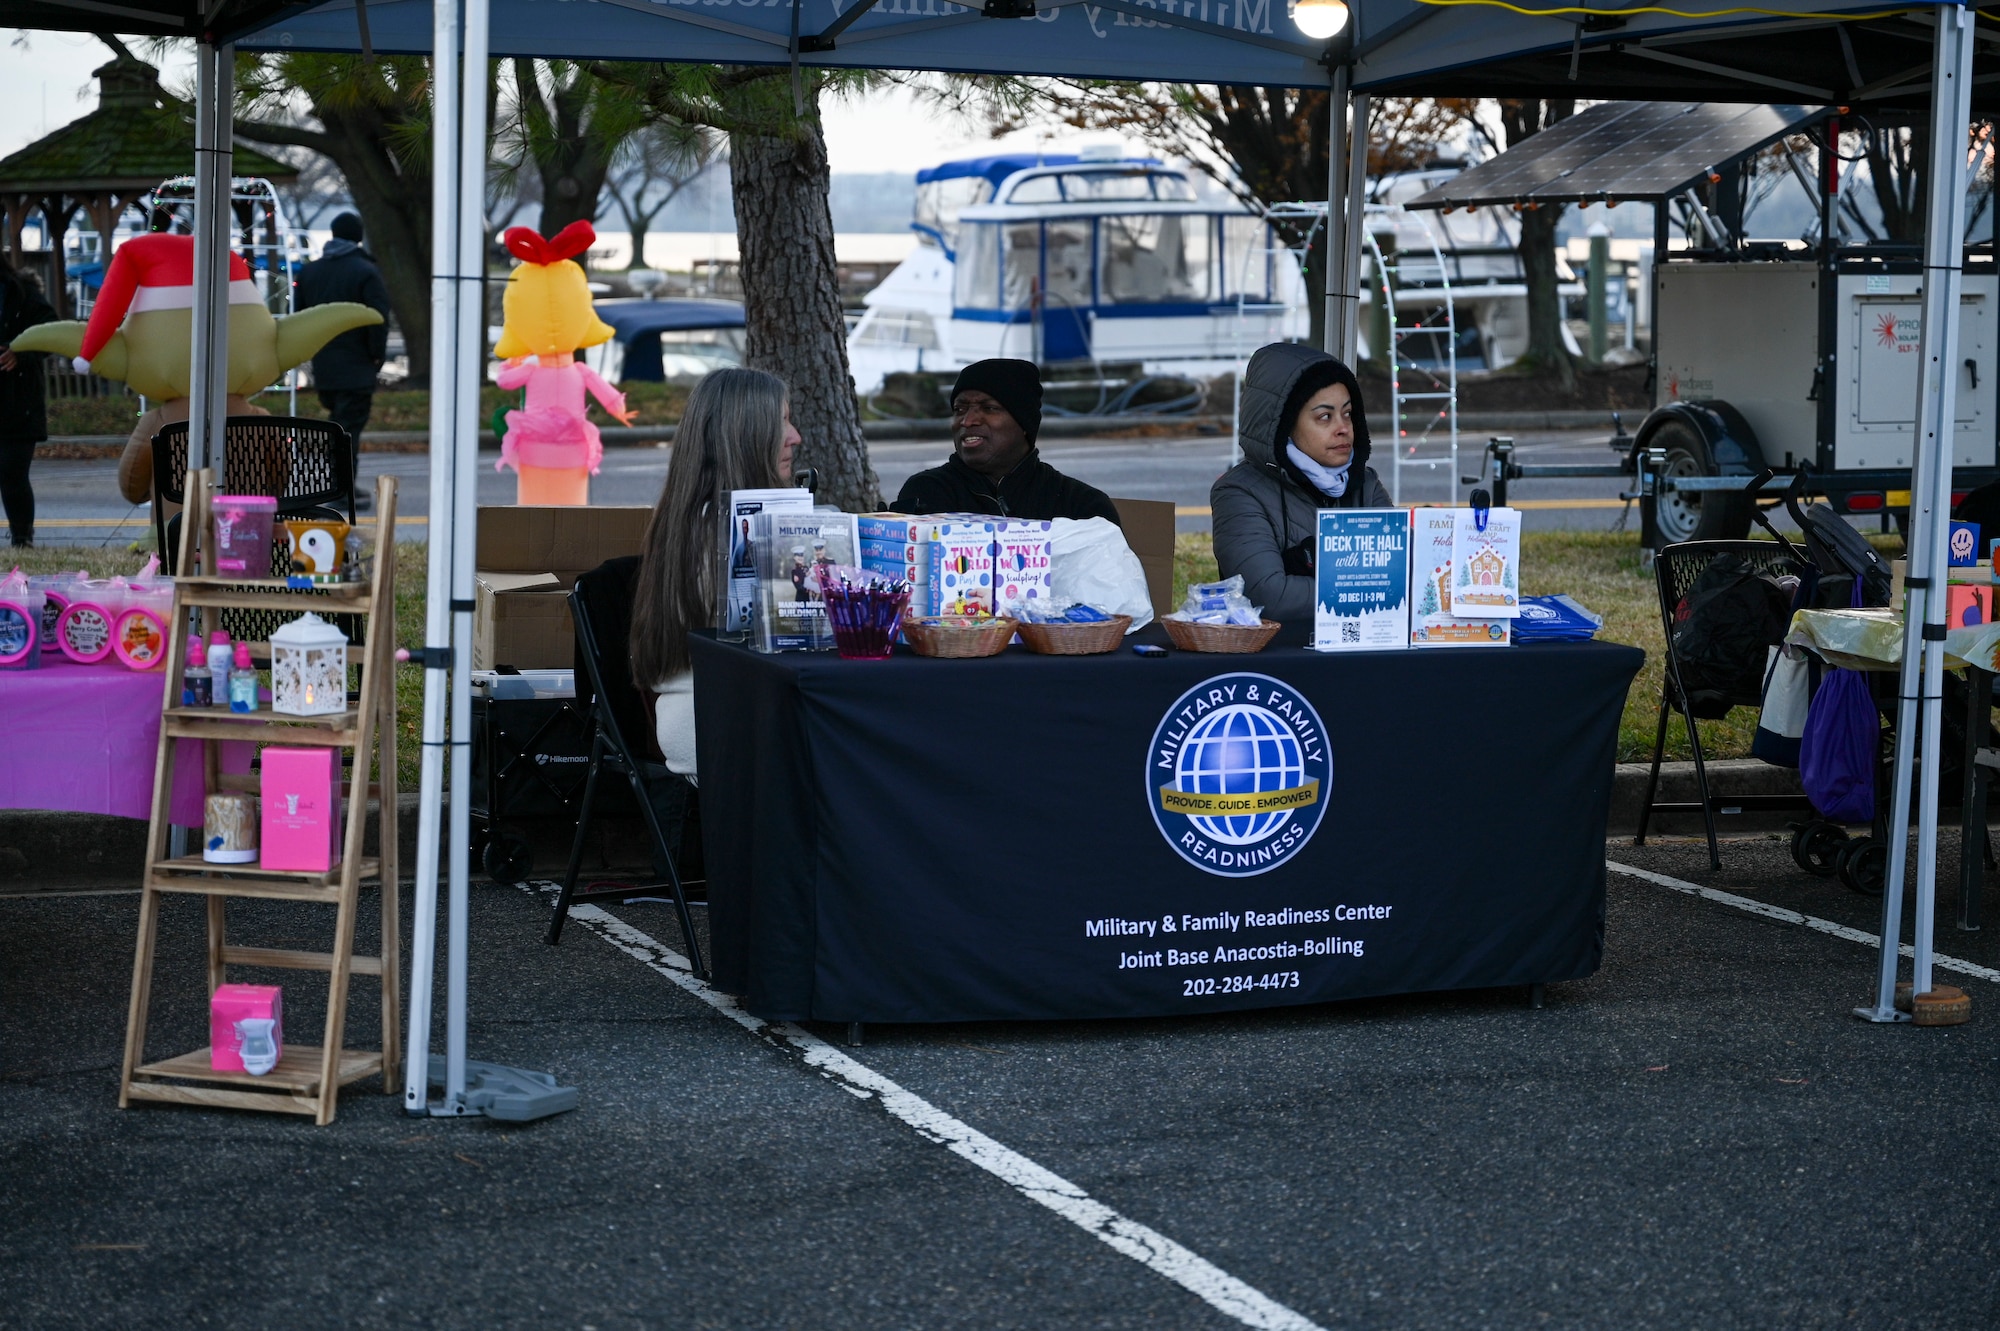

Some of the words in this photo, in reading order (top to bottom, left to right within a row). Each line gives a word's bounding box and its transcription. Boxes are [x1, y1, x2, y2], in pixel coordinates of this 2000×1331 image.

[780, 527, 819, 535] MILITARY
[1007, 545, 1040, 556] TINY
[1324, 536, 1352, 552] DECK
[1354, 535, 1374, 551] THE
[1377, 535, 1403, 550] HALL
[951, 546, 983, 558] TINY
[1335, 552, 1360, 567] with
[1363, 551, 1391, 567] EFMP
[959, 575, 976, 584] Pins!
[1006, 572, 1042, 585] Sculpting!
[1338, 593, 1347, 603] 20
[1348, 593, 1360, 602] DEC
[1365, 593, 1375, 602] 1-3
[1376, 592, 1385, 601] PM
[779, 609, 818, 618] BUILDING
[1158, 685, 1237, 769] MILITARY
[1247, 685, 1259, 701] &
[1267, 691, 1323, 763] FAMILY
[1165, 796, 1212, 810] PROVIDE
[1219, 800, 1250, 810] GUIDE
[1258, 791, 1312, 809] EMPOWER
[1181, 822, 1304, 867] READNINESS
[1086, 917, 1157, 937] Military
[1161, 915, 1177, 933] &
[1182, 912, 1240, 933] Family
[1245, 908, 1330, 927] Readiness
[1335, 904, 1392, 921] Center
[1118, 950, 1162, 970] Joint
[1167, 949, 1209, 966] Base
[1214, 937, 1364, 963] Anacostia-Bolling
[1183, 971, 1300, 996] 202-284-4473
